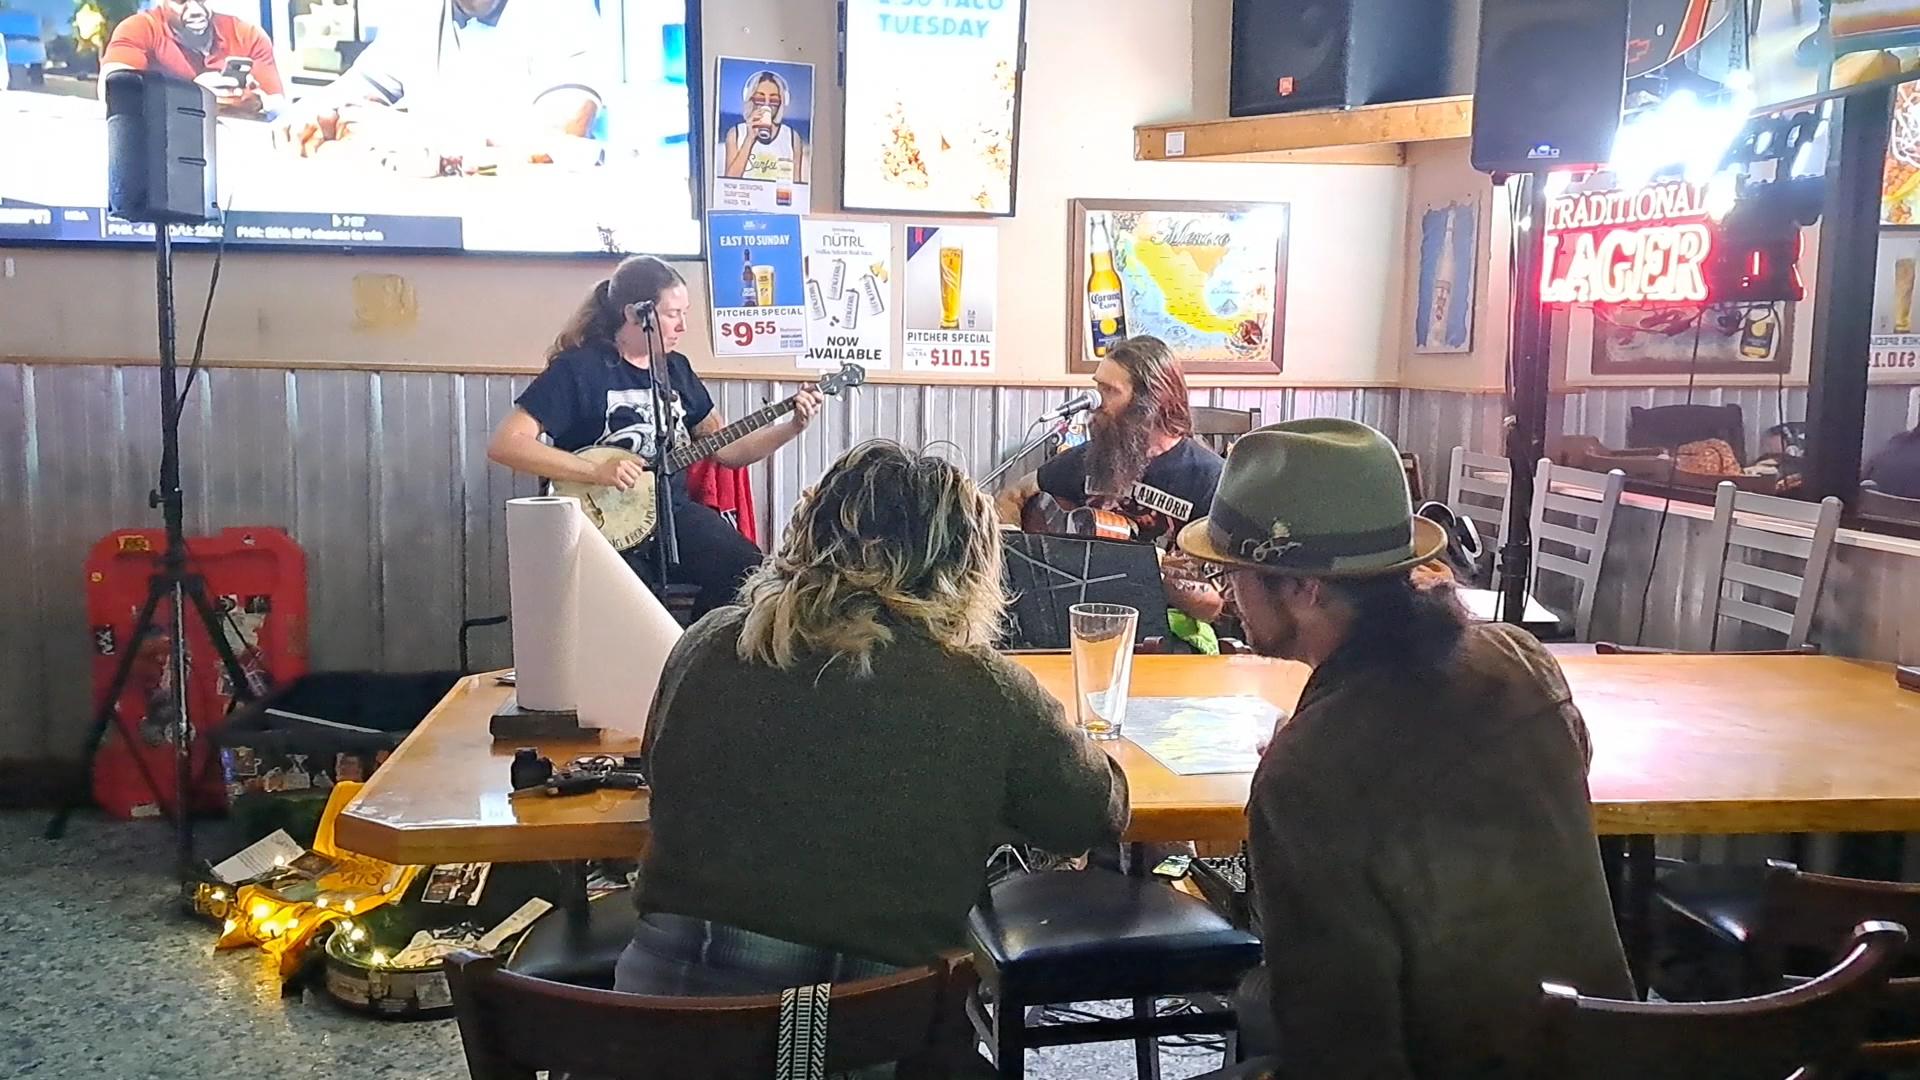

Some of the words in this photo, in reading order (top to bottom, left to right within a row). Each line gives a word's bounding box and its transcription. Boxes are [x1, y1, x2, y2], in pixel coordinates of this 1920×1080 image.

[879, 14, 989, 38] TUESDAY
[1548, 182, 1710, 231] TRADITIONAL
[720, 236, 741, 246] EASY
[743, 236, 755, 246] TO
[757, 234, 790, 246] SUNDAY
[1542, 224, 1710, 302] LAGER
[717, 309, 759, 317] PITCHER
[761, 308, 803, 316] SPECIAL
[827, 336, 859, 347] NOW
[907, 332, 948, 342] PITCHER
[952, 333, 990, 343] SPECIAL
[804, 348, 882, 360] AVAILABLE
[930, 348, 990, 367] $10.15
[1131, 484, 1189, 518] LAWHORN
